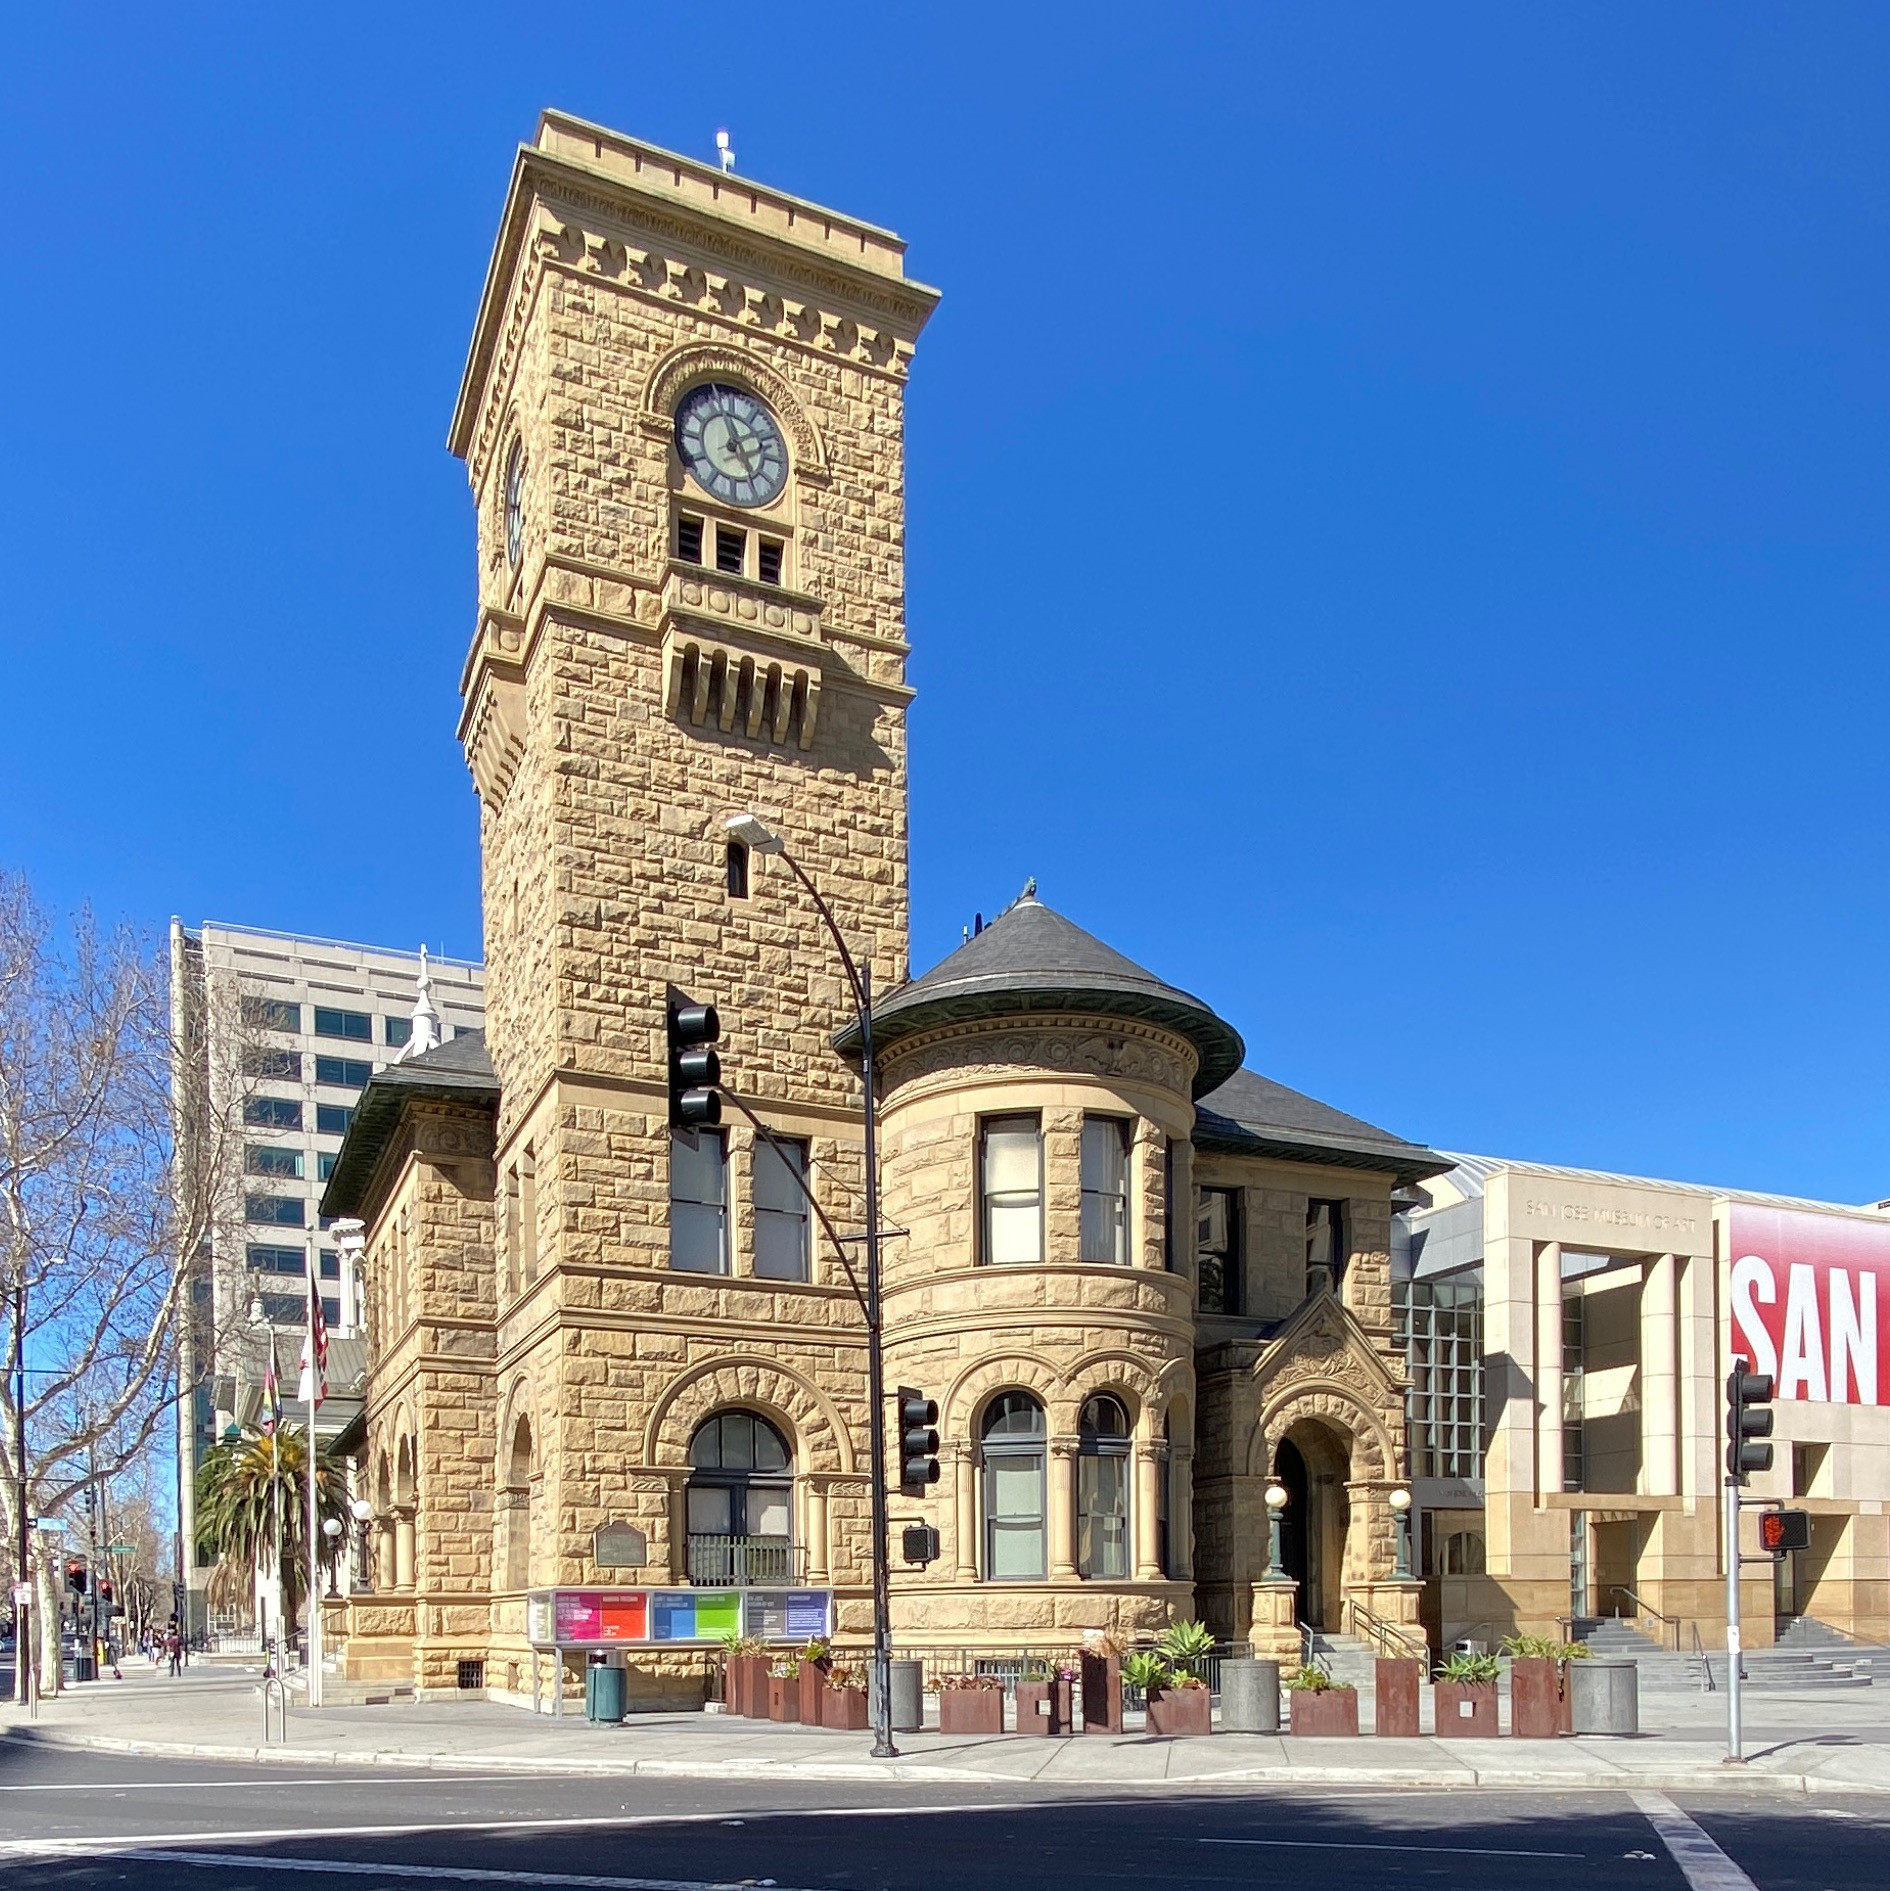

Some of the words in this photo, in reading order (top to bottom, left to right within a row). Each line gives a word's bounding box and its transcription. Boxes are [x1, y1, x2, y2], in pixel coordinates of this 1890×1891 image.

[1526, 1200, 1556, 1216] SAN
[1560, 1203, 1590, 1221] JOSE
[1594, 1208, 1651, 1228] MUSEUM
[1654, 1215, 1670, 1230] OF
[1673, 1218, 1697, 1233] ART
[1731, 1255, 1877, 1405] SAN
